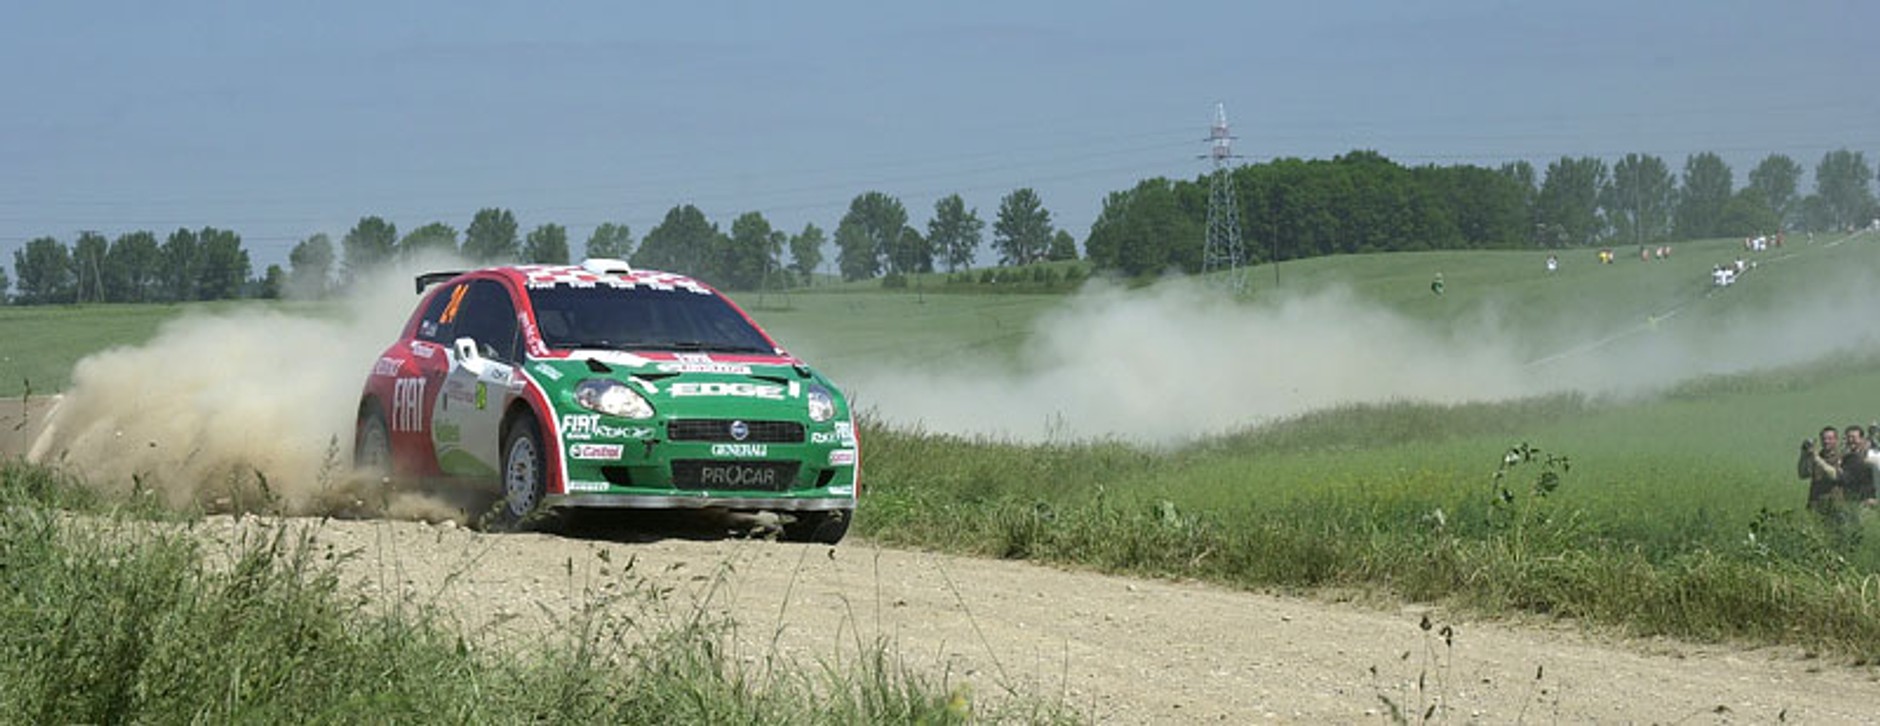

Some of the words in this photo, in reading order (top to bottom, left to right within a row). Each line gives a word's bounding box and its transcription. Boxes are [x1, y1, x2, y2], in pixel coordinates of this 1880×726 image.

[670, 382, 786, 400] EDGE
[392, 377, 427, 432] FIAT
[561, 413, 601, 434] FIAT
[582, 445, 620, 457] Castrol
[711, 443, 768, 457] GENERALI
[702, 466, 775, 485] PROCAR
